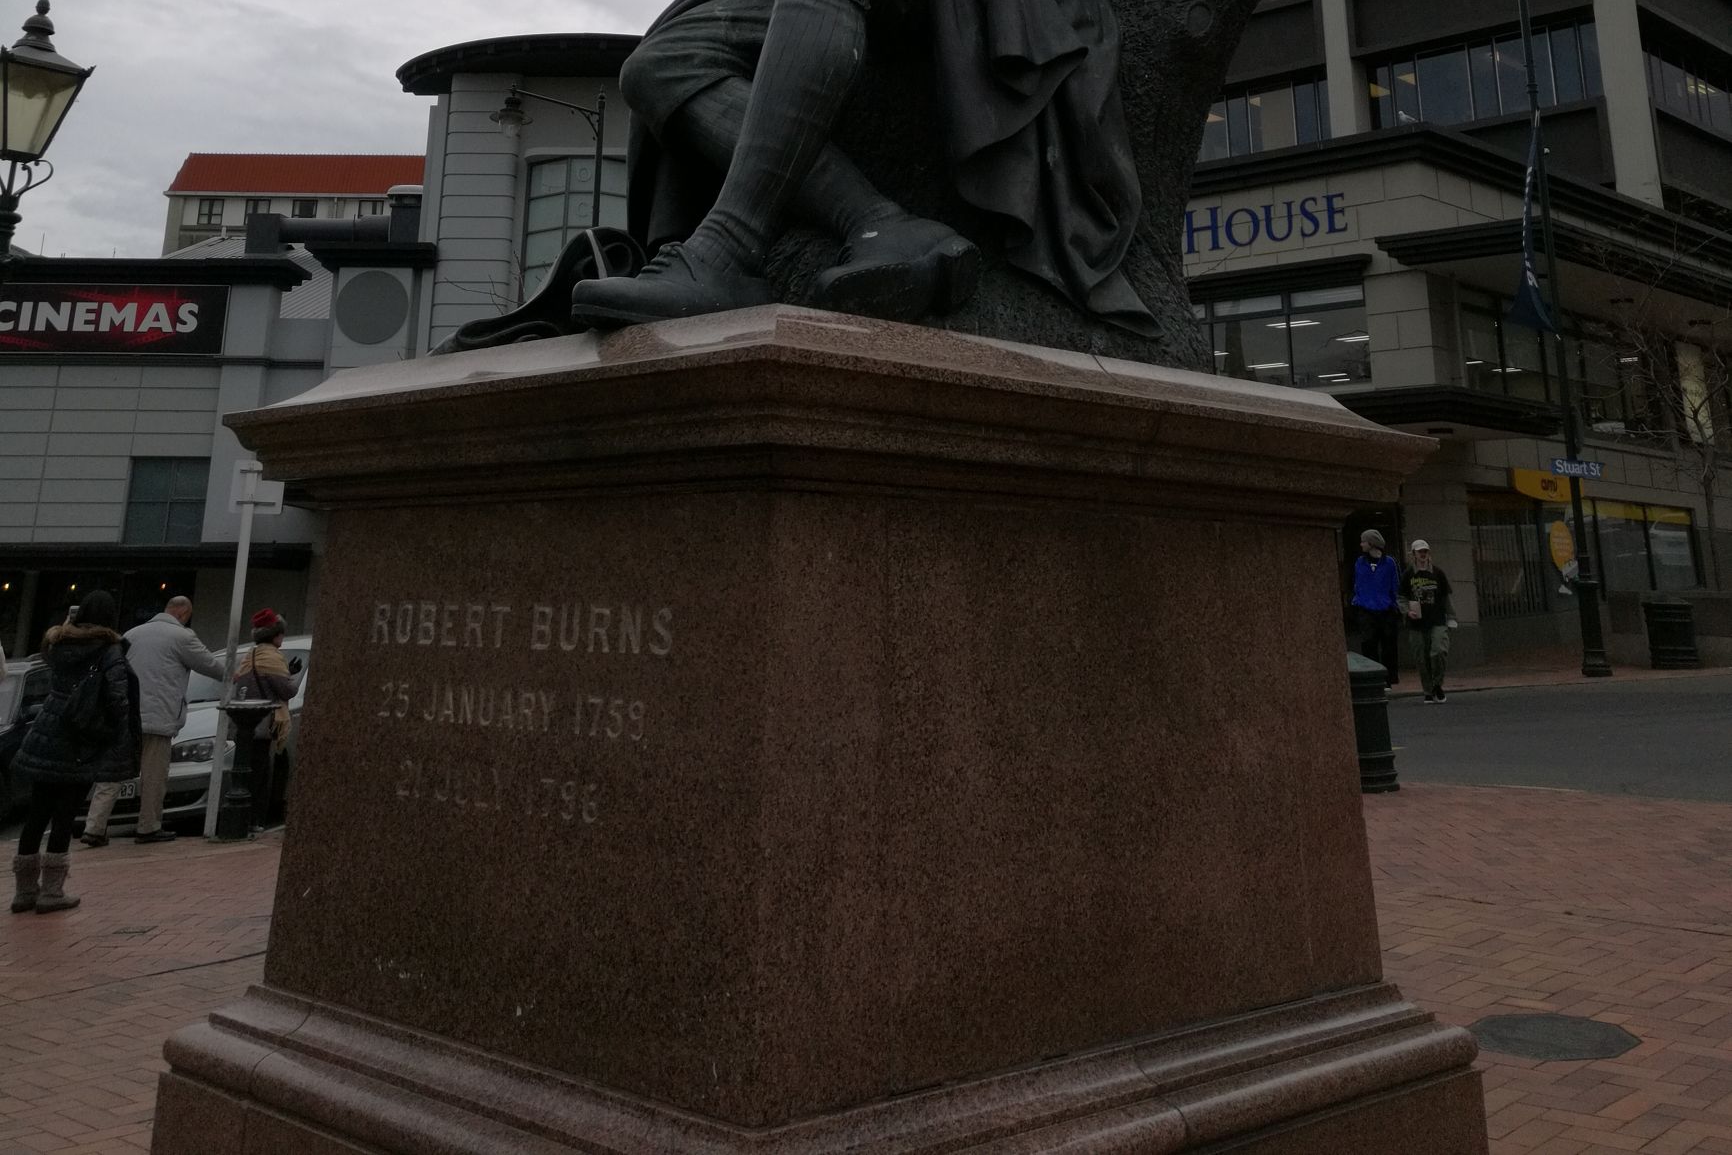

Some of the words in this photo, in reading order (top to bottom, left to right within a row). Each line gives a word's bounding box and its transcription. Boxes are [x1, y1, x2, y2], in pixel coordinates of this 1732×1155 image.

[1184, 192, 1348, 255] HOUSE
[0, 300, 199, 334] CINEMAS
[1555, 459, 1588, 475] Stuart
[1589, 463, 1601, 477] St
[371, 600, 511, 648] ROBERT
[531, 603, 674, 656] BURNS
[377, 682, 410, 718] 25
[422, 684, 555, 733] JANUARY
